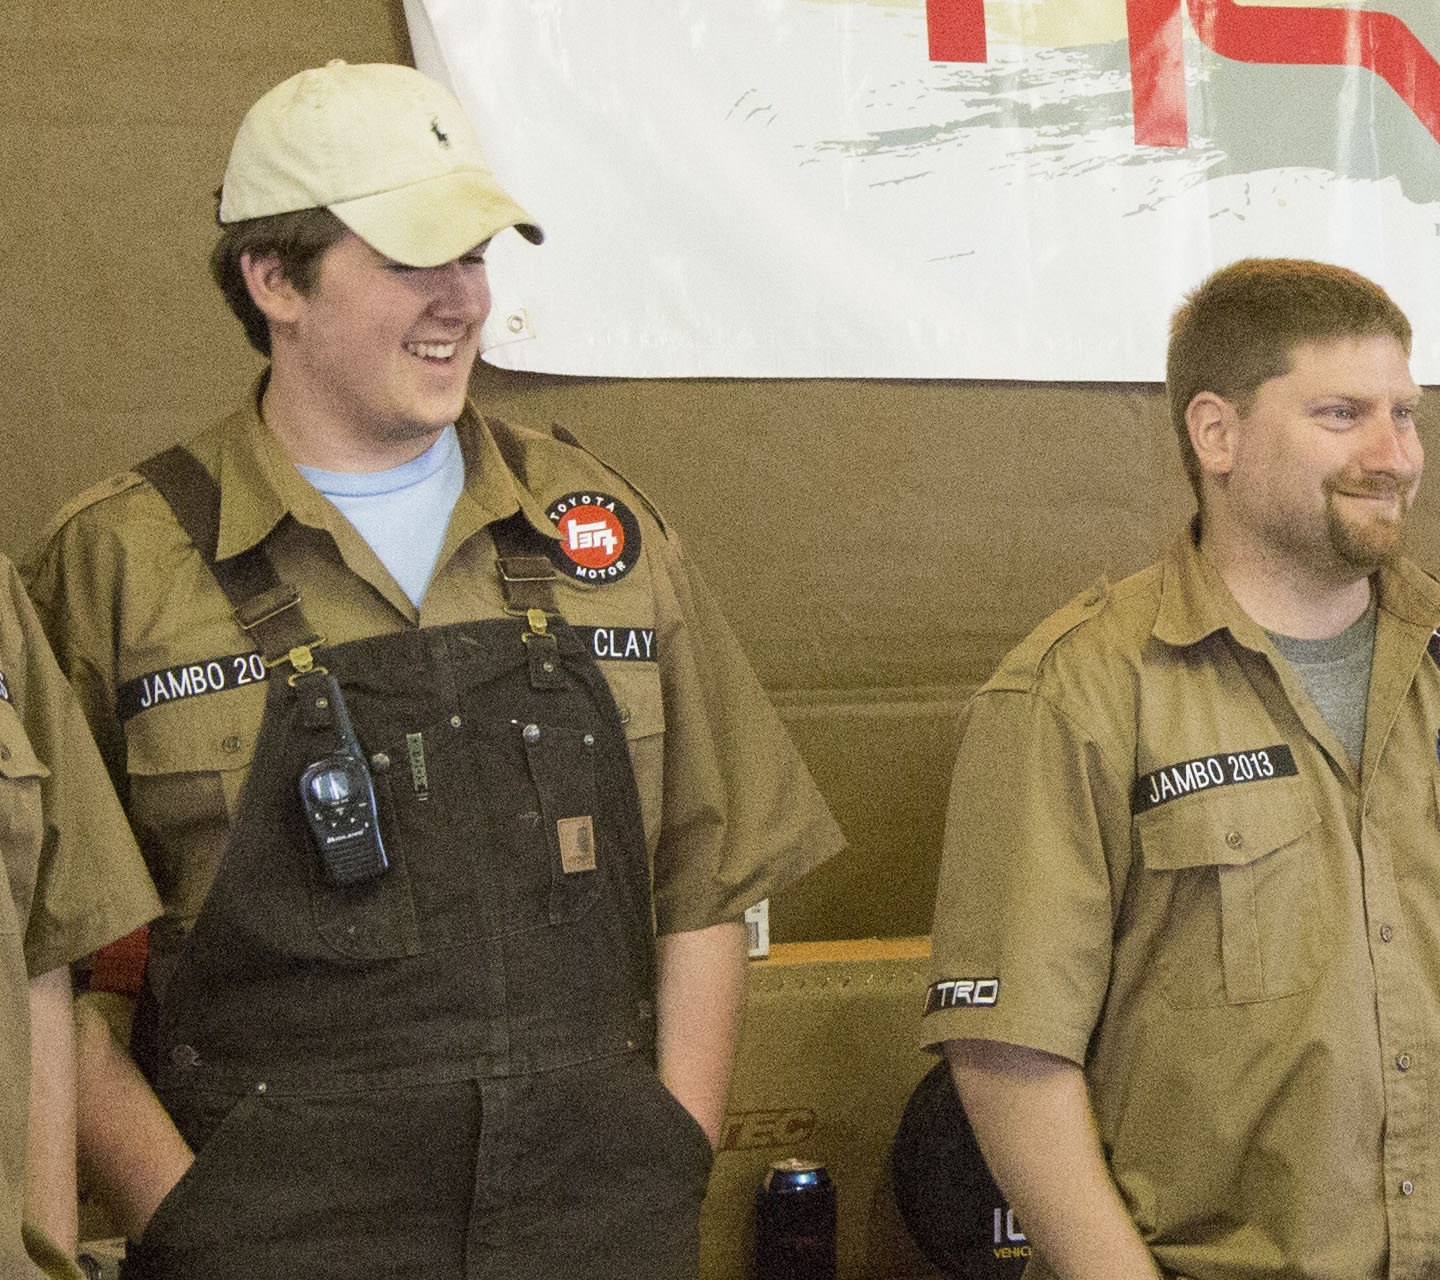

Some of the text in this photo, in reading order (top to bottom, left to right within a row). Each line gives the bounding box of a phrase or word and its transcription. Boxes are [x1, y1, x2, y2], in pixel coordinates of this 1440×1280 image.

[550, 495, 615, 521] TOYOTA
[576, 561, 625, 580] MOTOR
[593, 627, 654, 658] CLAY
[141, 653, 267, 708] JAMBO 20
[1149, 752, 1274, 804] JAMBO 2013
[936, 978, 999, 1006] TRD
